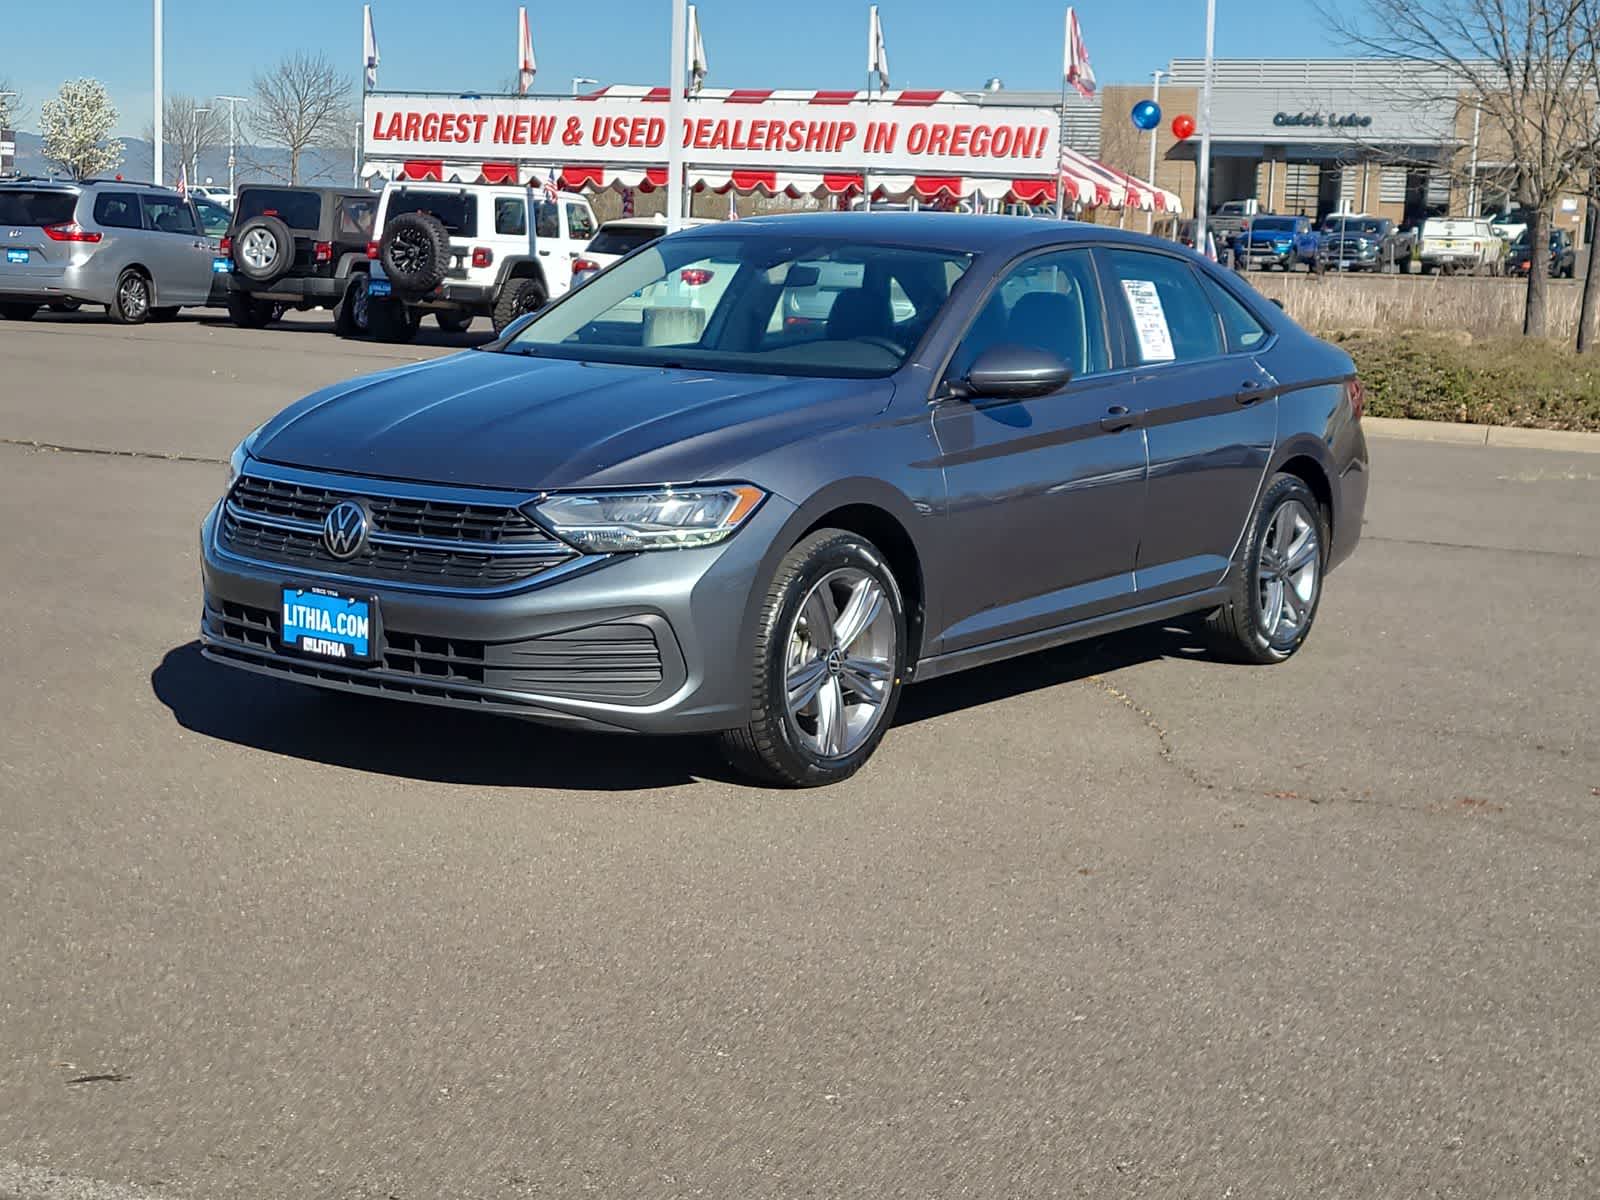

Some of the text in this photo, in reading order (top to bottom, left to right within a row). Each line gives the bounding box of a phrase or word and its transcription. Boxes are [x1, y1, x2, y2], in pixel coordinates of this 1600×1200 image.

[373, 111, 489, 143] LARGEST
[492, 114, 557, 145] NEW
[562, 115, 584, 147] &
[592, 116, 666, 148] USED
[863, 121, 898, 154] IN
[905, 123, 1049, 158] OREGON!
[284, 603, 368, 640] LITHIA.COM
[313, 638, 346, 658] LITHIA
